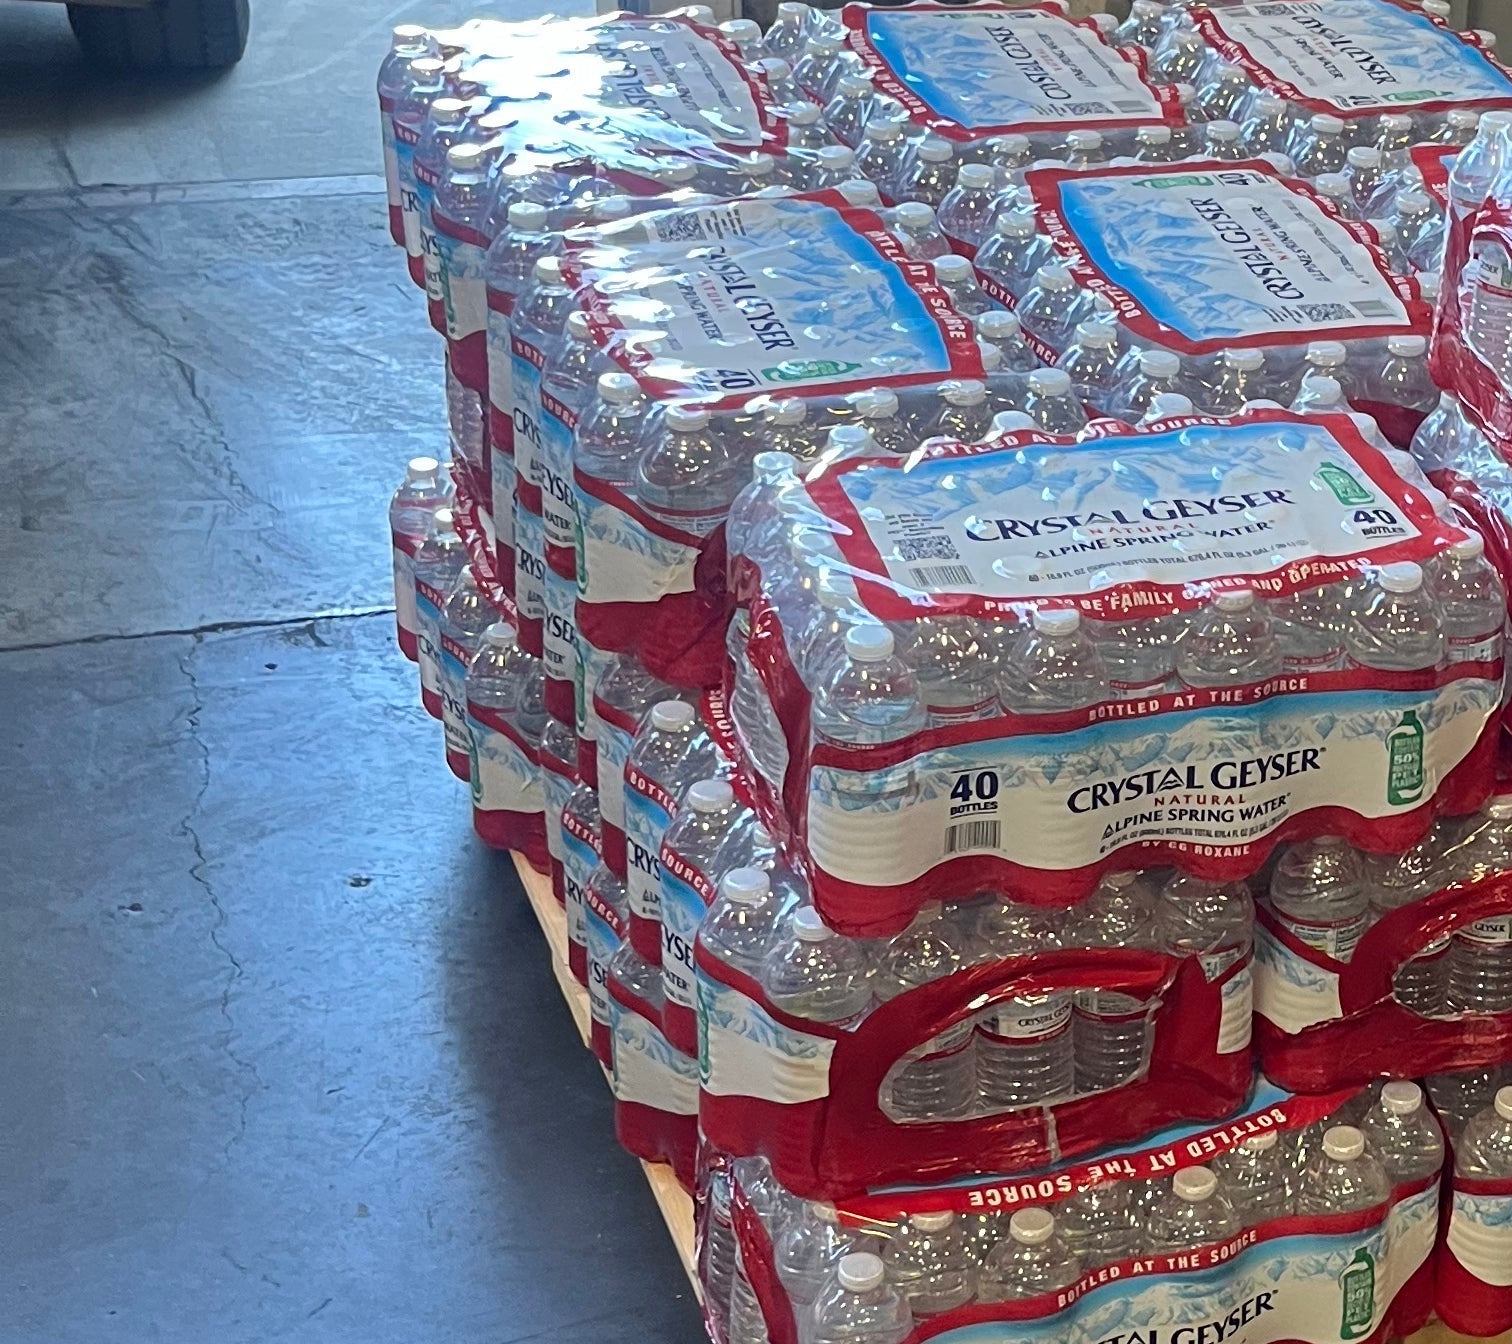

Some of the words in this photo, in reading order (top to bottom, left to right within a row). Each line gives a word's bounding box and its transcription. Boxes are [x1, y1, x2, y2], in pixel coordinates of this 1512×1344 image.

[514, 407, 542, 448] CRYS
[965, 508, 1138, 543] CRYSTAL
[1143, 488, 1291, 524] GEYSER
[1090, 522, 1198, 536] NATURAL
[1353, 508, 1397, 526] 40
[1035, 538, 1109, 559] ALPINE
[1113, 530, 1194, 550] SPRING
[1081, 596, 1102, 612] BE
[1110, 590, 1174, 620] FAMILY
[1251, 576, 1284, 593] AND
[1088, 700, 1160, 722] BOTTLED
[1174, 694, 1196, 708] AT
[1210, 688, 1244, 703] THE
[1254, 677, 1308, 700] SOURCE
[630, 771, 679, 818] BOTTLE
[951, 771, 998, 801] 40
[1067, 767, 1204, 814] CRYSTAL
[1210, 748, 1321, 790] GEYSER
[1154, 793, 1247, 806] NATURAL
[951, 801, 998, 815] BOTTLES
[1102, 810, 1163, 840] ALPINE
[1168, 809, 1234, 823] SPRING
[1240, 794, 1287, 822] WATER
[627, 837, 661, 882] CRYS
[1195, 845, 1250, 857] ROXANE
[660, 848, 708, 897] SOURCE
[1186, 1108, 1287, 1158] BOTTLED
[1089, 1158, 1136, 1182] THE
[1150, 1149, 1177, 1172] AT
[968, 1176, 1072, 1207] SOURCE
[1057, 1264, 1120, 1308] BOTTLED
[1132, 1258, 1154, 1273] AT
[1167, 1253, 1200, 1270] THE
[1210, 1230, 1257, 1262] SOURCE
